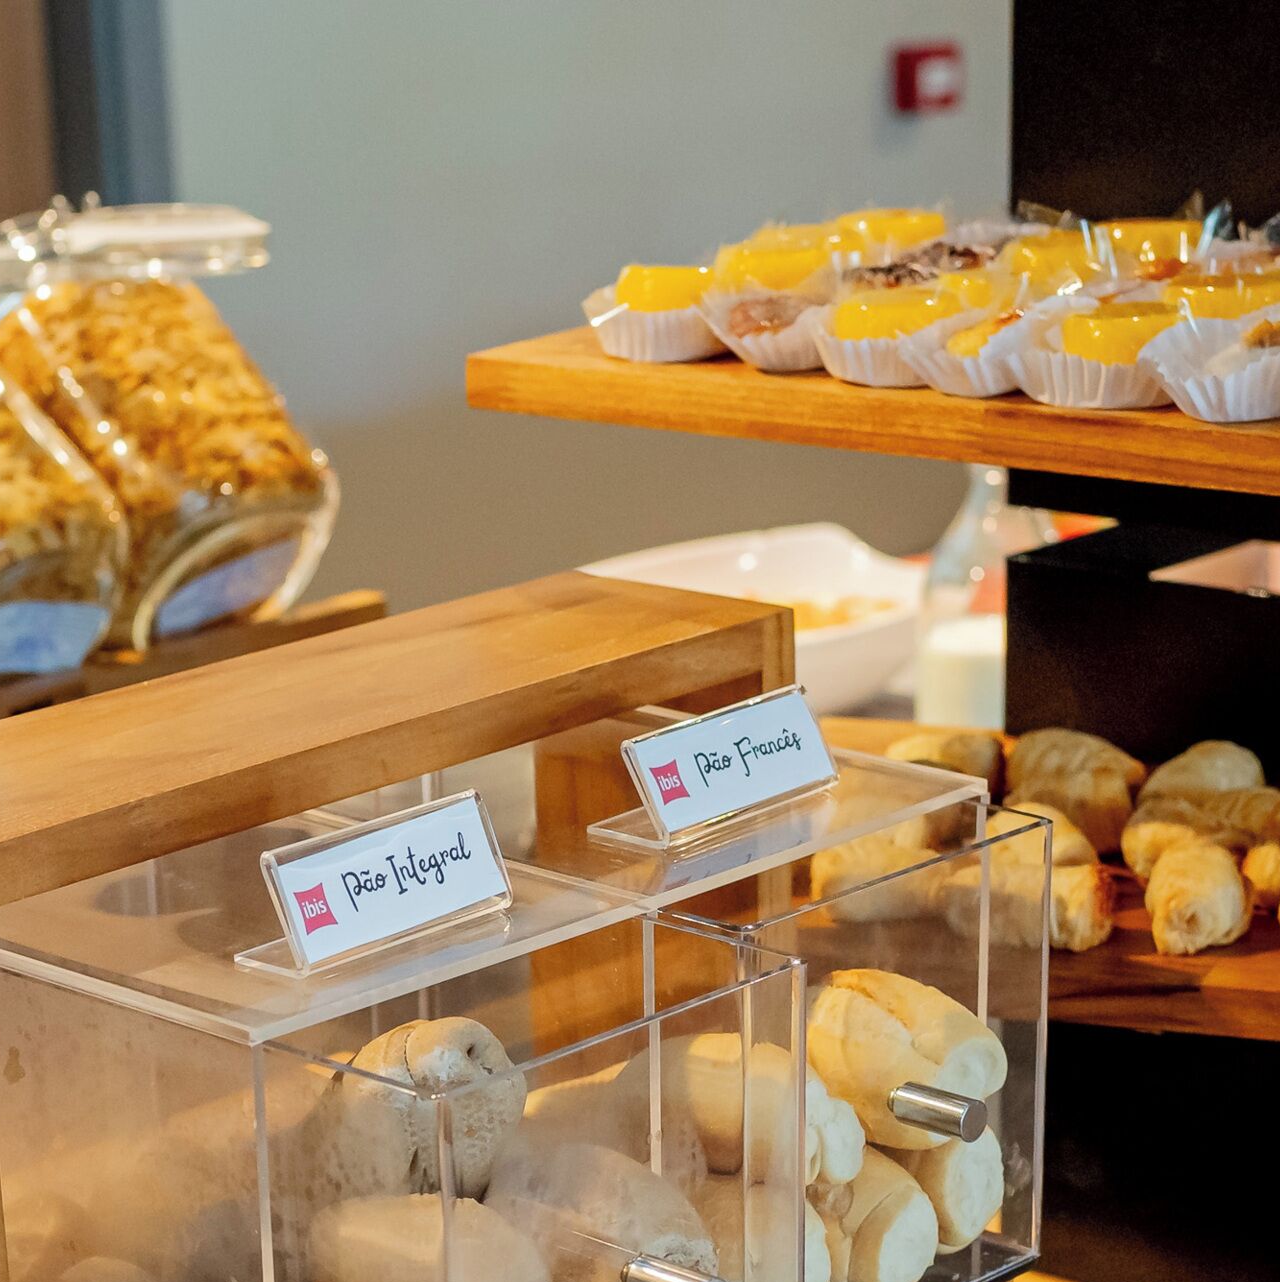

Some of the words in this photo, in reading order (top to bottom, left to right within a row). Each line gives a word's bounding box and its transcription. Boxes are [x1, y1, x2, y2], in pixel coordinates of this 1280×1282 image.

[694, 752, 733, 788] Pão
[733, 728, 802, 777] Francês
[657, 774, 681, 791] ibis
[341, 869, 388, 912] Pão
[386, 831, 471, 895] Integral
[301, 899, 327, 919] ibis
